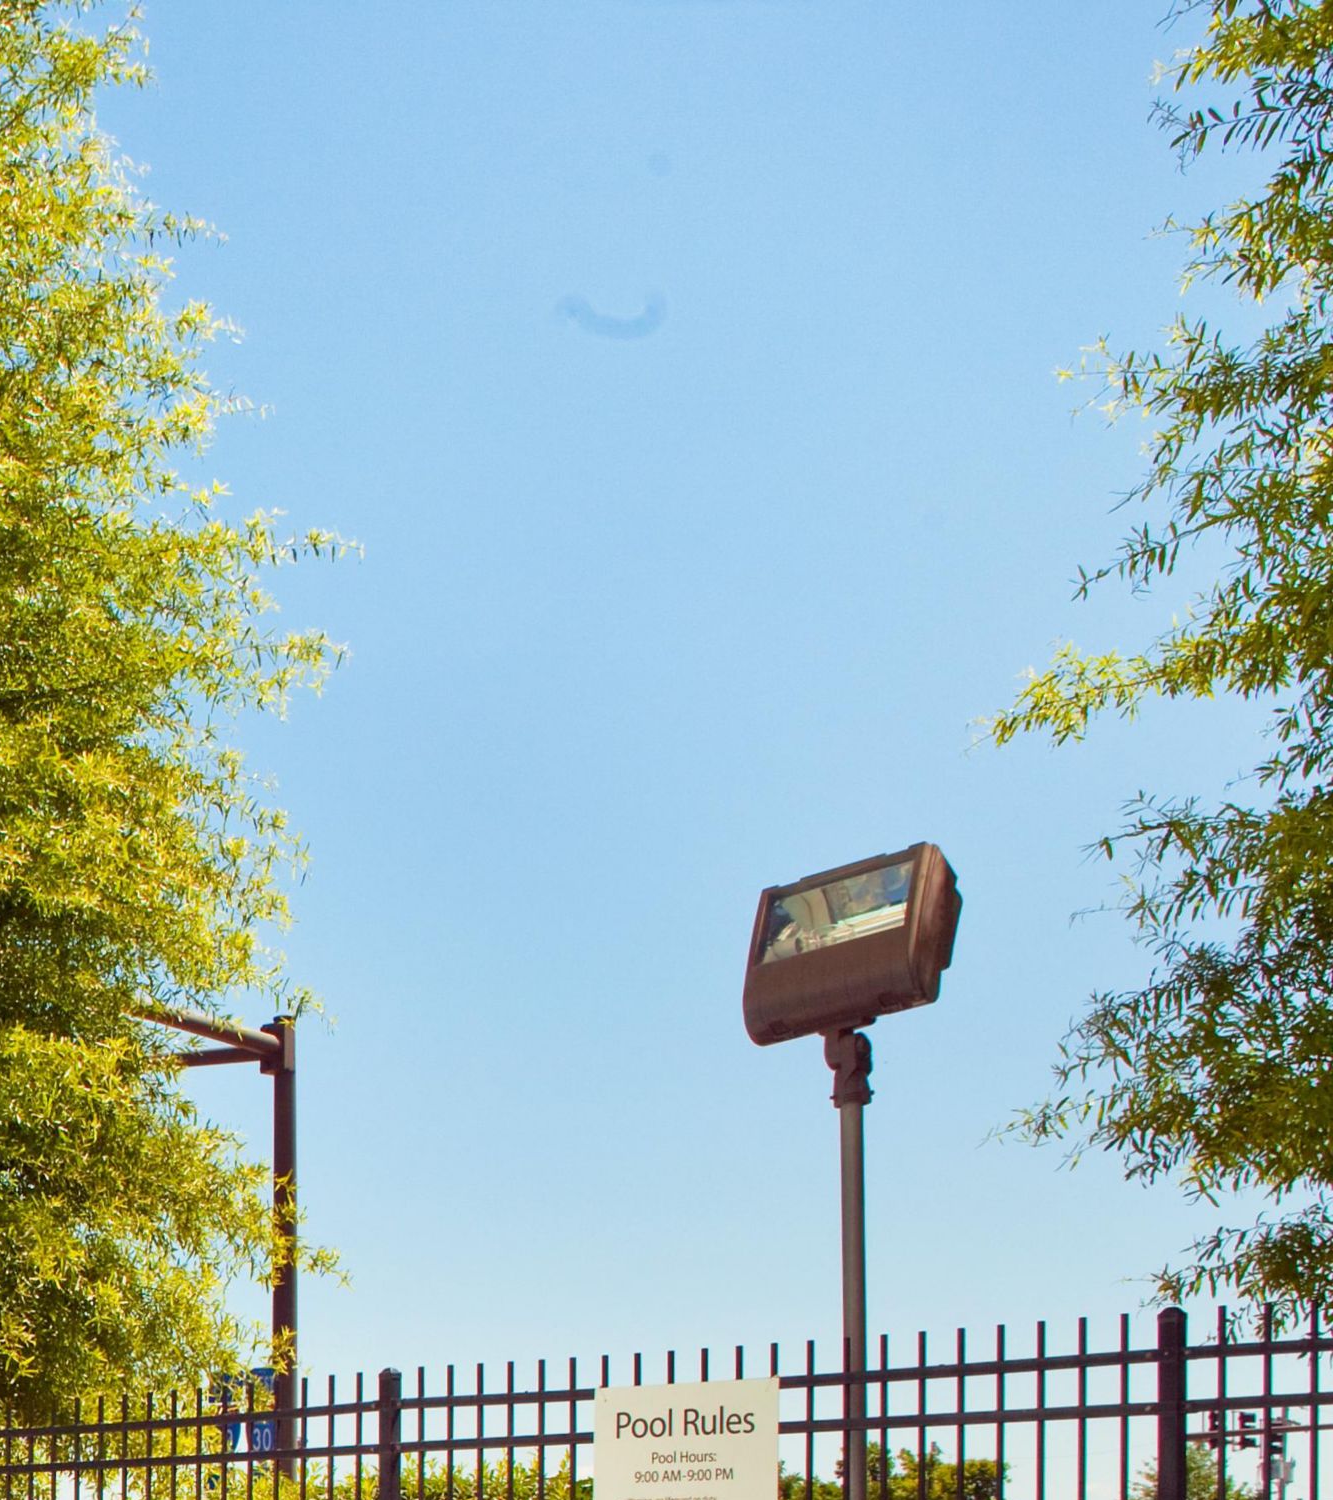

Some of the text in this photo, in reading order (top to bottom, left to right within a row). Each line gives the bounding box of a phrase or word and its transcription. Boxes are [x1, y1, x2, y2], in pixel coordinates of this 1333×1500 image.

[616, 1405, 755, 1439] Pool Rules
[651, 1450, 717, 1464] Pool Hours:
[634, 1470, 659, 1483] 9:00
[715, 1467, 734, 1480] PM
